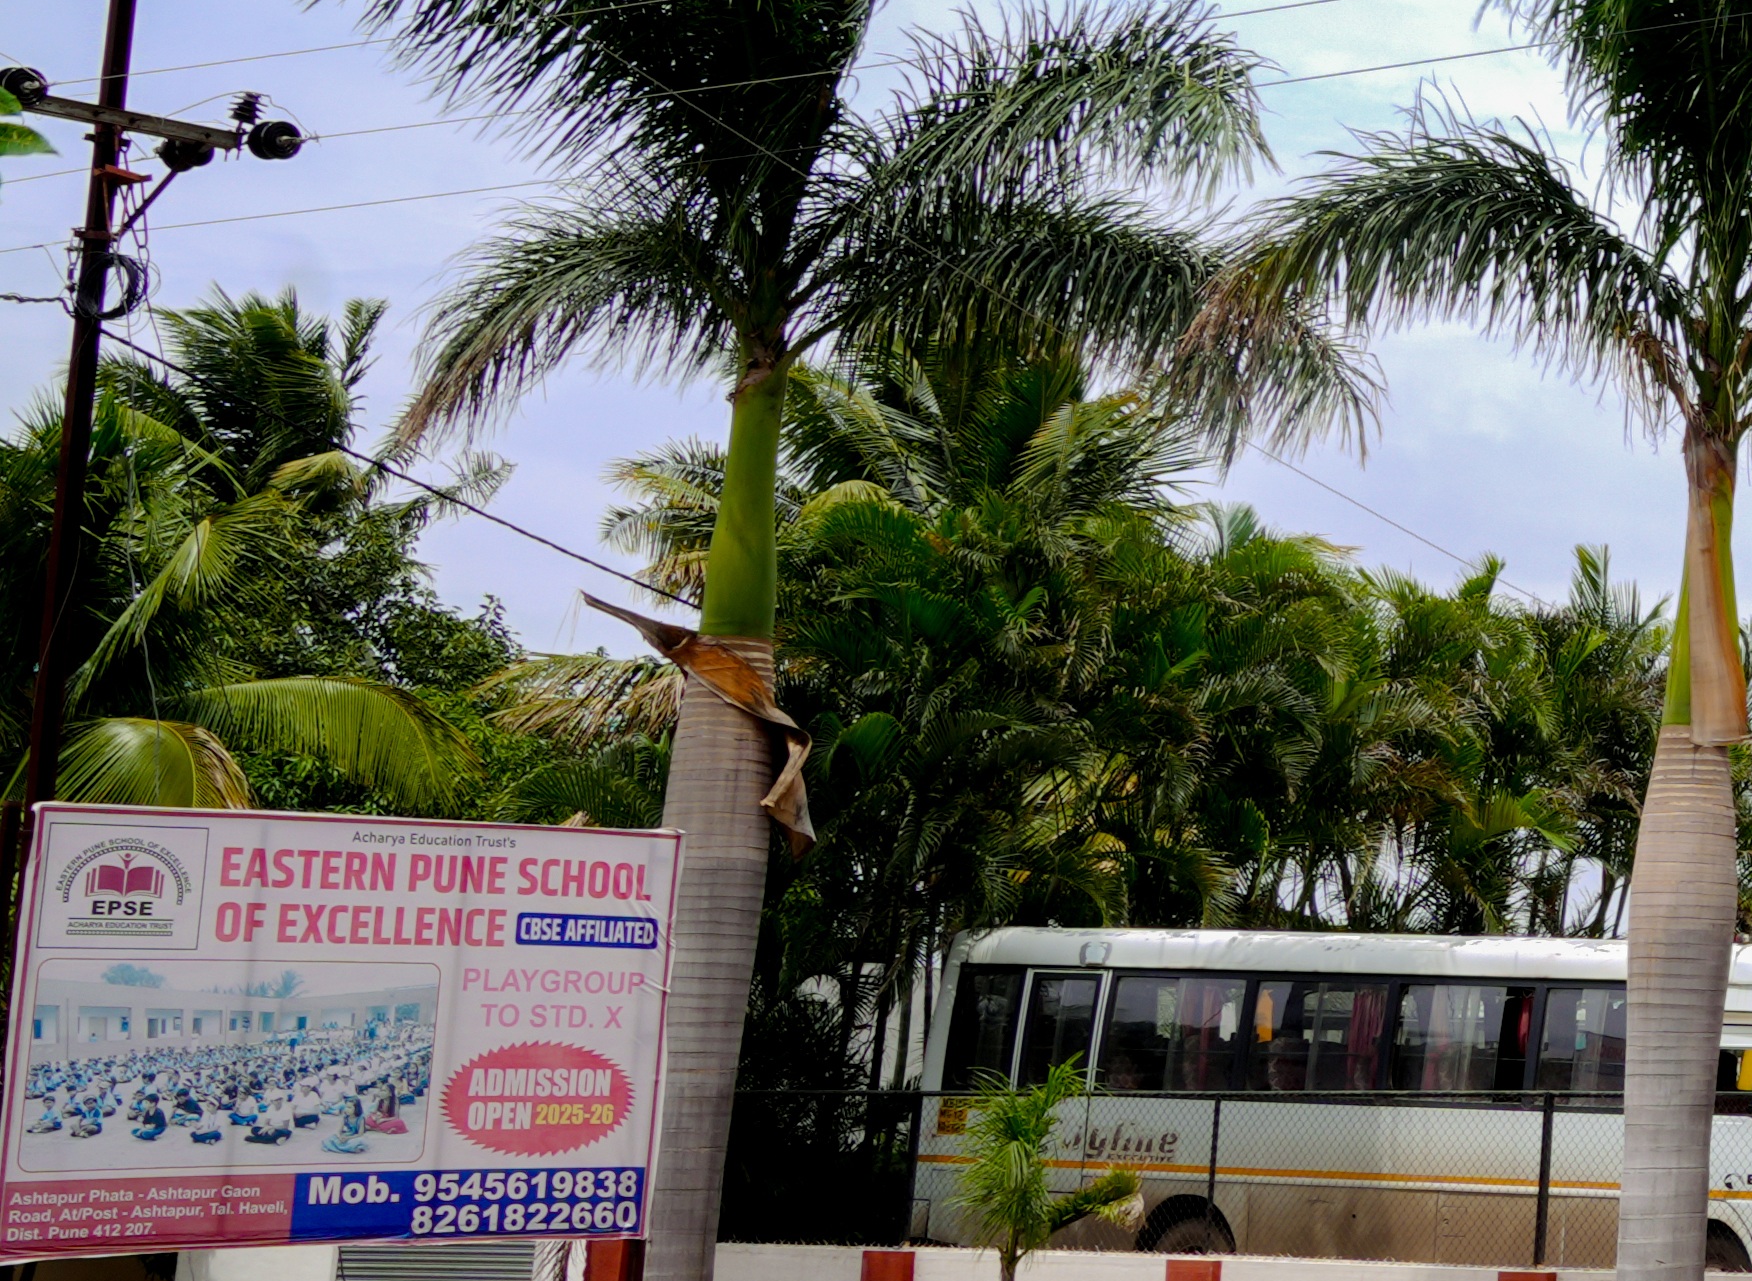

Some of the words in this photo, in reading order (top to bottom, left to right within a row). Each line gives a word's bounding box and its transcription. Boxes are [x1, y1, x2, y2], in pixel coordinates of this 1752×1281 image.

[352, 831, 405, 847] Acharya
[410, 833, 472, 847] Education
[476, 836, 516, 848] Trust's
[56, 854, 83, 891] EASTERN
[83, 841, 106, 856] PUNE
[109, 838, 144, 846] SCHOOL
[147, 841, 160, 850] OF
[159, 847, 192, 894] EXCELLENCE
[220, 847, 397, 892] EASTERN
[408, 854, 508, 895] PUNE
[517, 858, 652, 901] SCHOOL
[91, 900, 153, 916] EPSE
[67, 921, 103, 929] ACHARYA
[105, 922, 147, 930] EDUCATION
[215, 902, 267, 943] OF
[277, 904, 507, 947] EXCELLENCE
[520, 917, 561, 941] CBSE
[564, 919, 655, 945] AFFILIATED
[462, 968, 645, 995] PLAYGROUP
[481, 1004, 520, 1028] TO
[529, 1004, 594, 1029] STD.
[603, 1006, 624, 1029] X
[468, 1068, 612, 1097] ADMISSION
[467, 1102, 532, 1130] OPEN
[535, 1103, 614, 1125] 2025-26
[10, 1191, 85, 1207] Ashtapur
[90, 1189, 133, 1203] Phata
[147, 1187, 218, 1202] Ashtapur
[221, 1185, 261, 1198] Gaon
[308, 1175, 400, 1204] Mob.
[413, 1171, 637, 1202] 9545619838
[9, 1210, 55, 1224] Road,
[59, 1207, 118, 1220] At/Post
[131, 1204, 204, 1219] Ashtapur,
[210, 1202, 234, 1215] Tal.
[239, 1200, 288, 1215] Haveli,
[411, 1201, 637, 1235] 8261822660
[6, 1228, 43, 1242] Dist.
[48, 1225, 88, 1239] Pune
[93, 1224, 122, 1238] 412
[125, 1223, 156, 1236] 207.
